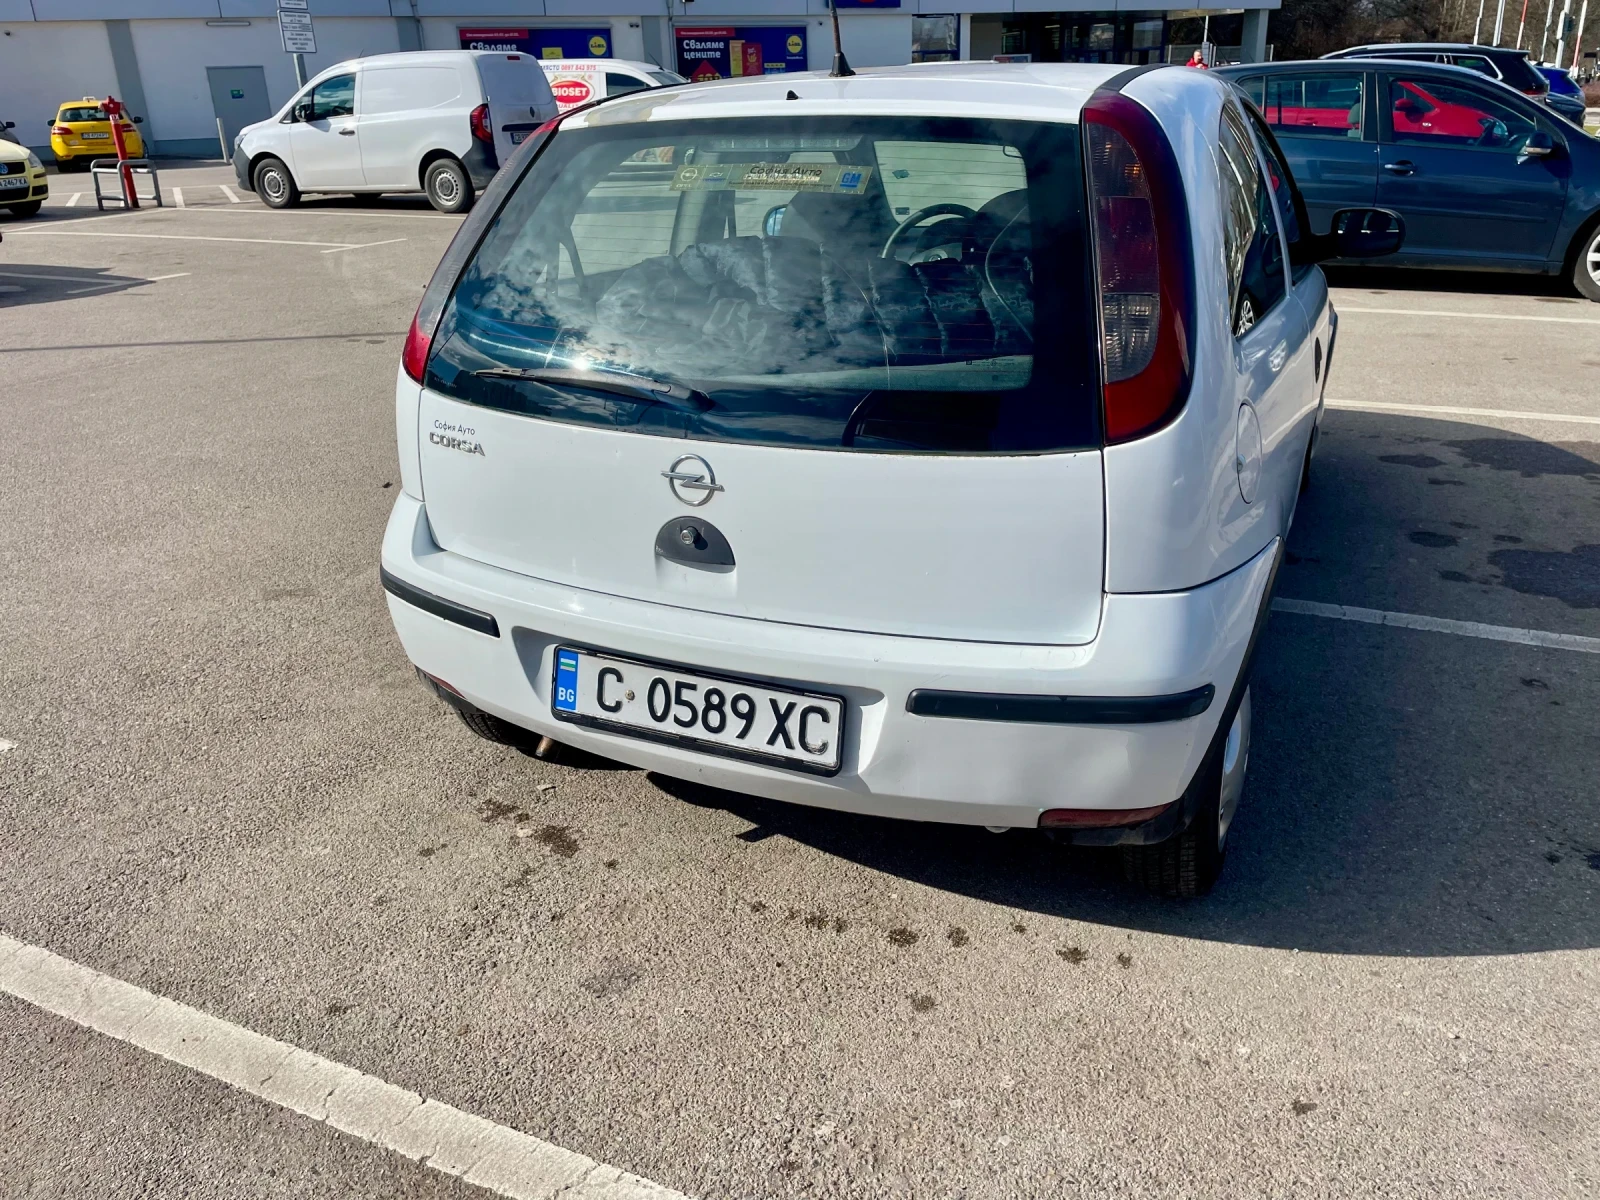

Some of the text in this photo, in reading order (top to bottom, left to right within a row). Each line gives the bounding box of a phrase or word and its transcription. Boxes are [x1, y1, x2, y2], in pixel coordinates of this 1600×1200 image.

[470, 42, 517, 51] Сваляме
[683, 39, 724, 49] Сваляме
[684, 51, 721, 60] цените
[552, 87, 588, 96] BIOSET
[750, 166, 788, 176] София
[3, 178, 18, 187] 2467
[841, 172, 862, 183] GM
[434, 419, 475, 436] София Ауто
[429, 431, 486, 457] CORSA
[558, 687, 575, 703] BG
[597, 667, 830, 755] C 0589 XC
